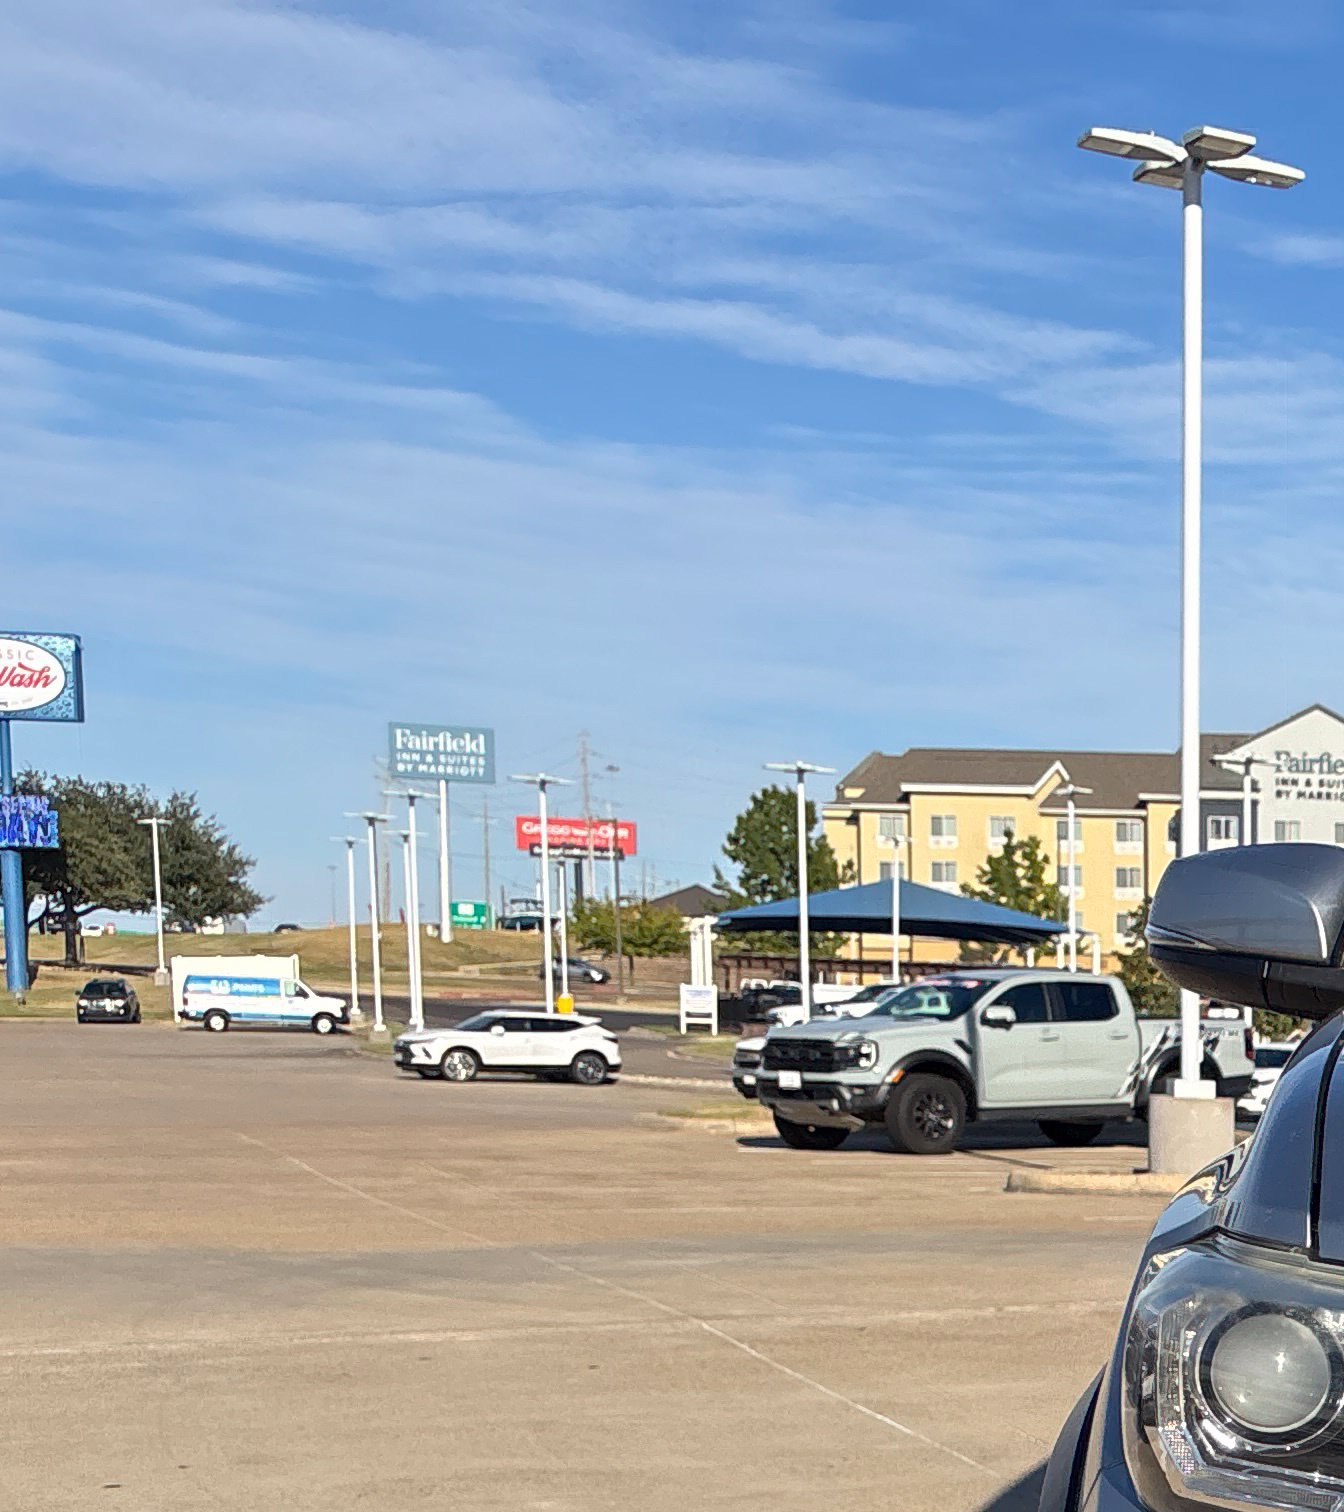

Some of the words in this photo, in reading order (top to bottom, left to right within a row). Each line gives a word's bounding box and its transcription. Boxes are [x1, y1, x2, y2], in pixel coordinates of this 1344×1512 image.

[395, 728, 486, 754] Fairfield
[396, 751, 420, 762] INN
[439, 754, 486, 766] SUITES
[397, 762, 414, 773] BY
[418, 763, 485, 777] MARRIOTT
[1275, 778, 1299, 787] INN
[1276, 789, 1291, 800] BY
